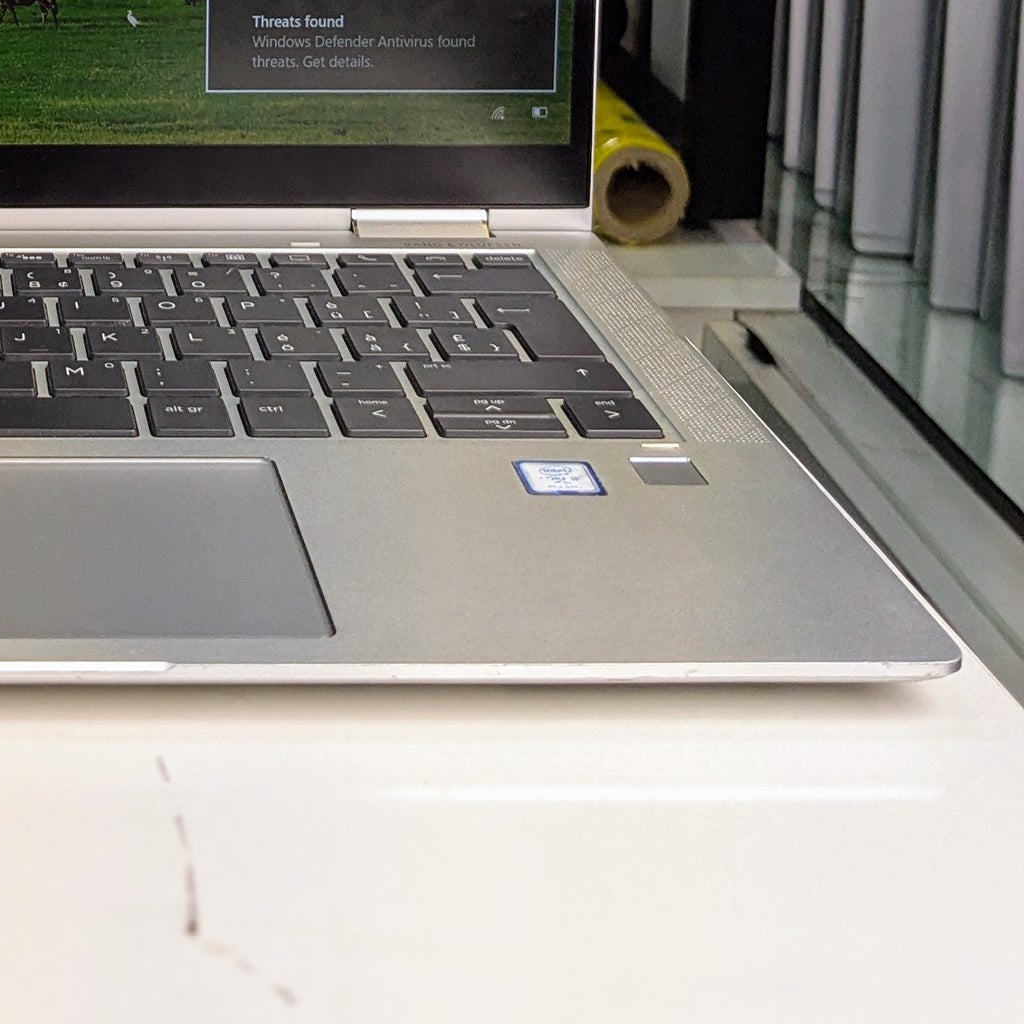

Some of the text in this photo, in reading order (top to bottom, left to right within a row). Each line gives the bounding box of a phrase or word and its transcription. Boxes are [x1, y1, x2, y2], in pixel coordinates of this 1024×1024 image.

[252, 13, 345, 28] Threats found
[251, 34, 477, 49] Windows Defender Antivirus found
[251, 55, 375, 69] threats. Get details.
[28, 280, 41, 288] 8
[110, 280, 123, 288] 9
[158, 301, 176, 310] O
[240, 301, 255, 310] P
[14, 332, 26, 341] J
[101, 332, 118, 342] K
[188, 332, 203, 341] L
[65, 366, 85, 376] M
[595, 399, 615, 407] end
[165, 405, 203, 414] alt gr
[258, 405, 283, 413] ctrl
